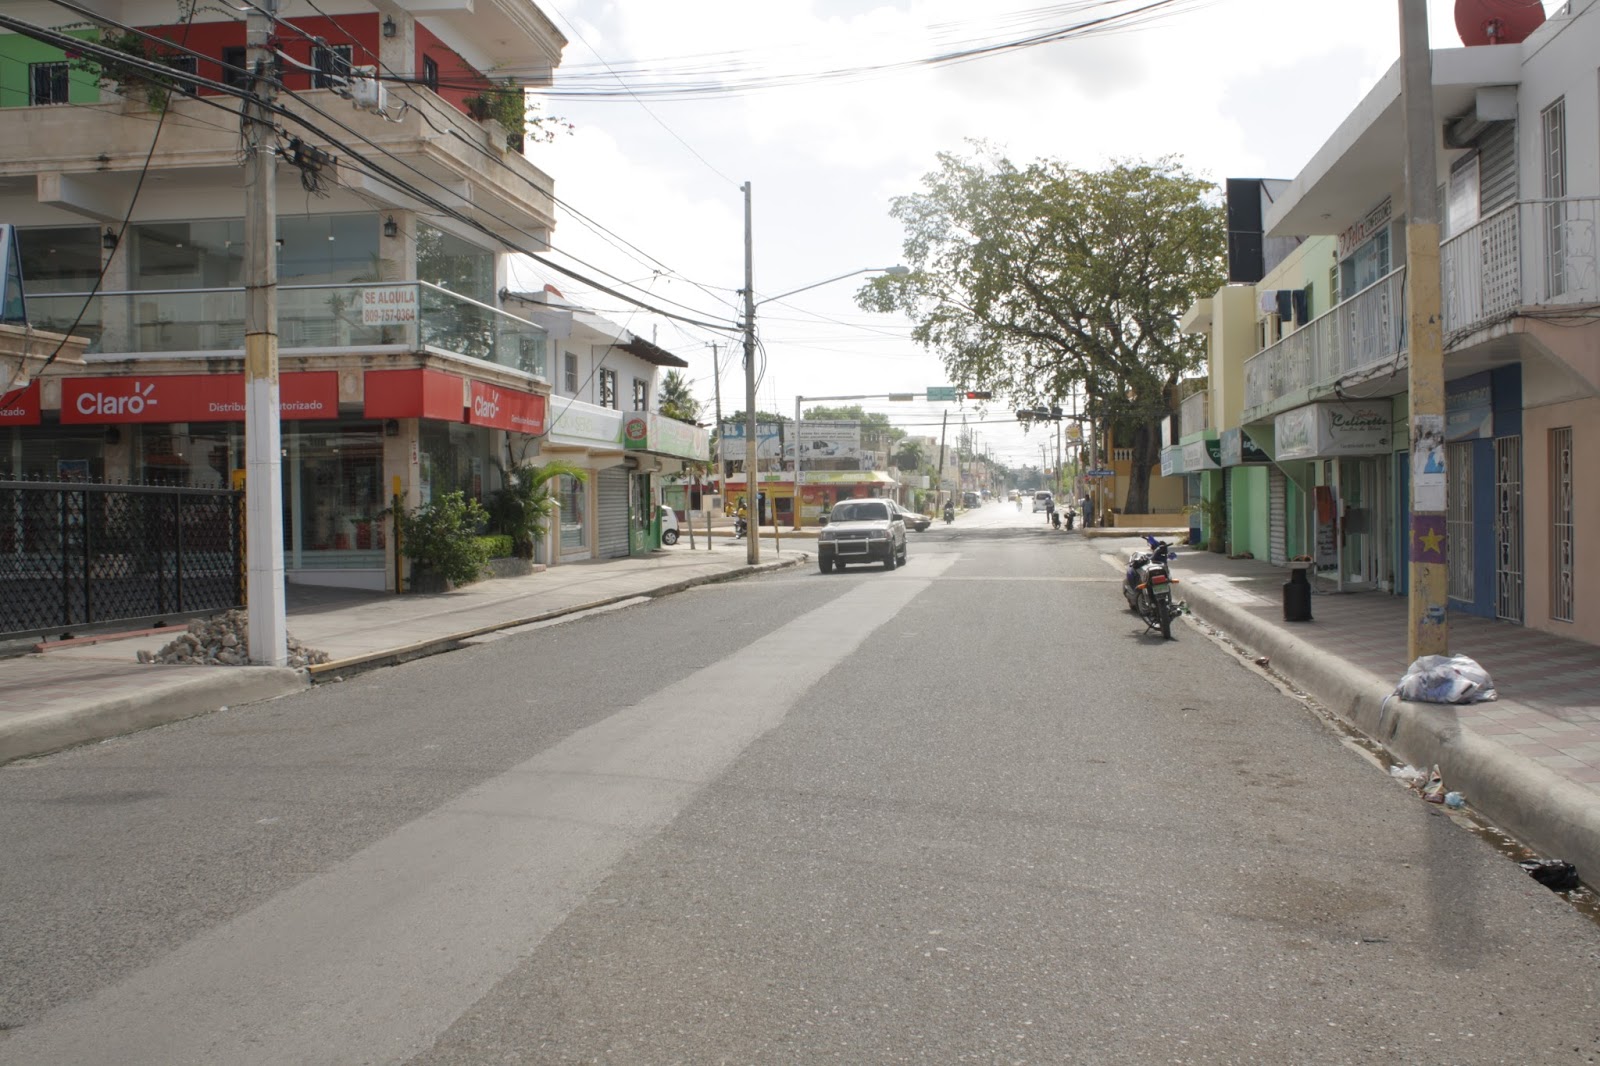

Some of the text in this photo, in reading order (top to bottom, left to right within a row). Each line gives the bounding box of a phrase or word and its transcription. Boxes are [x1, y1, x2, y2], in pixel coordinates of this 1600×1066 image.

[364, 291, 415, 304] SE ALQUILA
[76, 392, 145, 415] Claro
[209, 401, 323, 412] Distribu torizado
[475, 395, 496, 419] Claro
